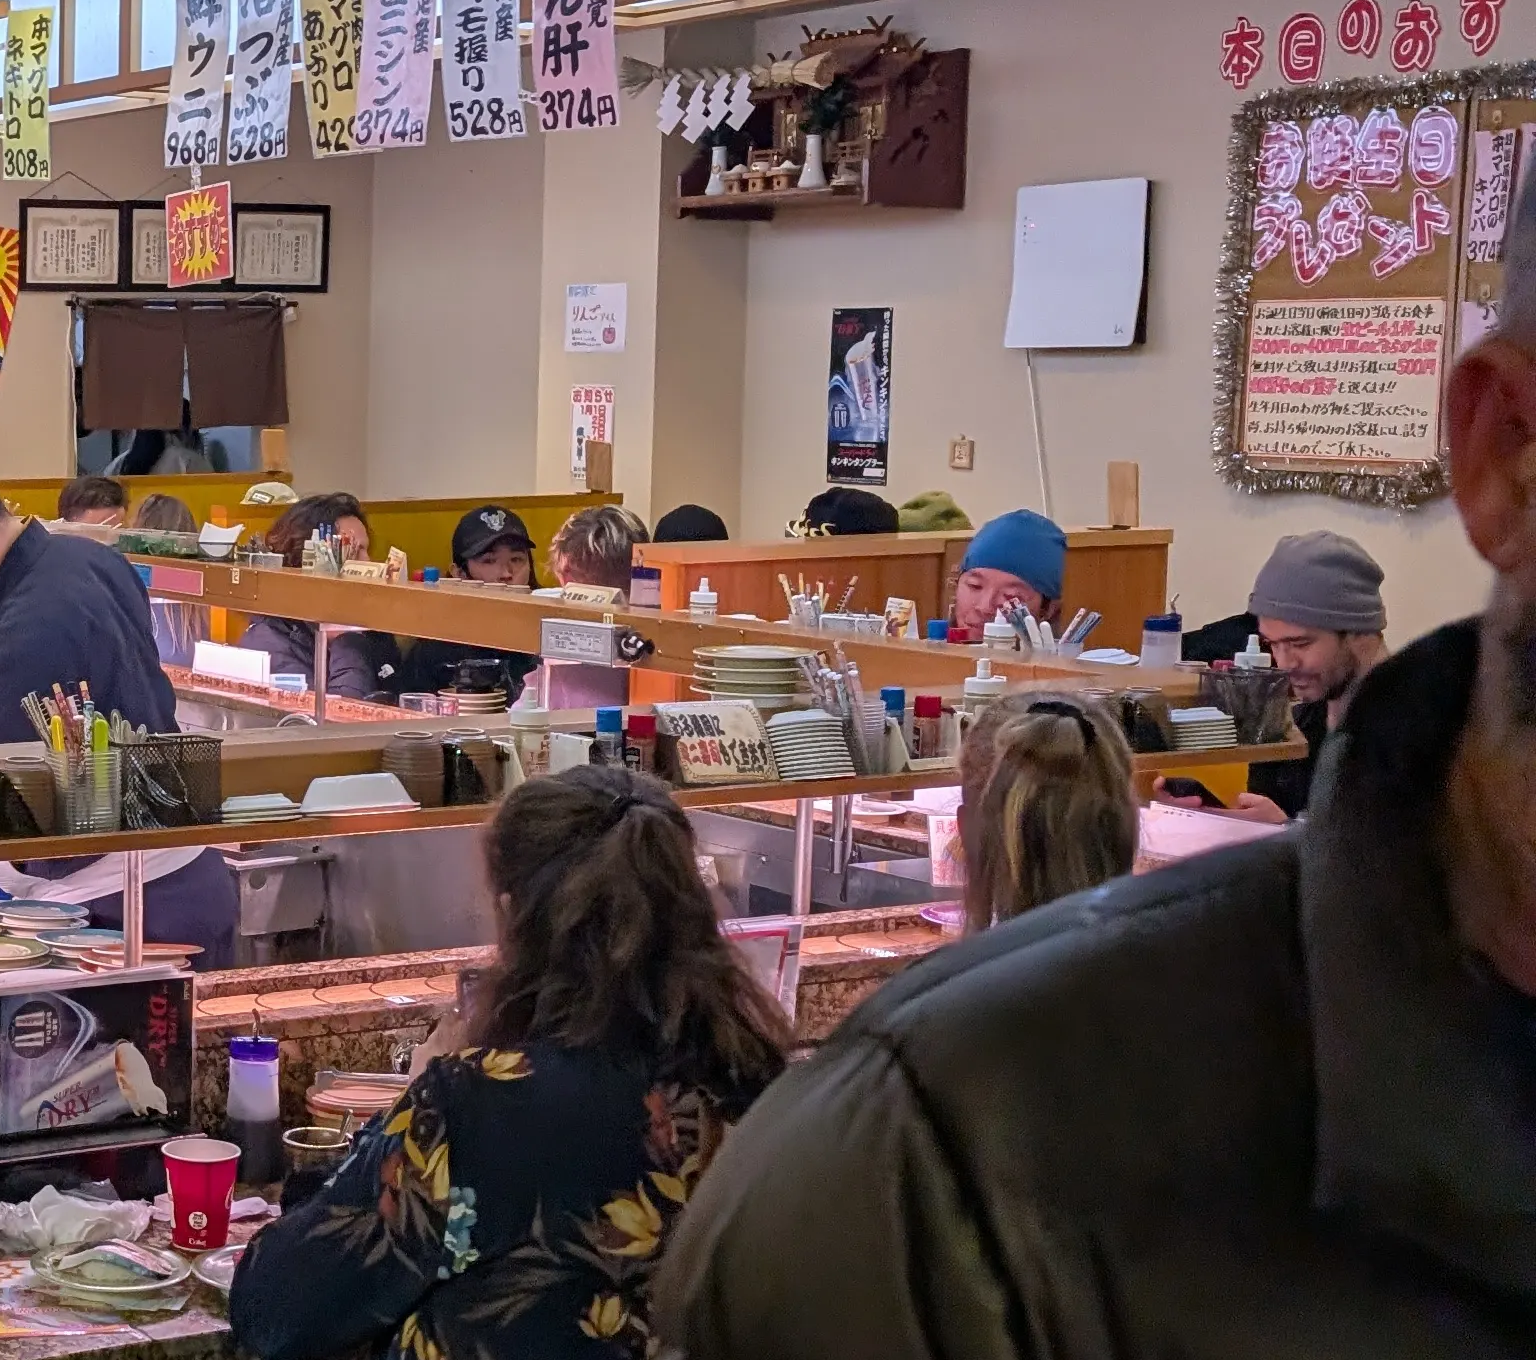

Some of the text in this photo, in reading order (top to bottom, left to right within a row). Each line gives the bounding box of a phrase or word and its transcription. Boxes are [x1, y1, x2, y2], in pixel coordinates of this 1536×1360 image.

[28, 14, 51, 118] 本マグロ
[302, 9, 328, 110] あぶり
[5, 35, 24, 139] ネギトロ
[356, 107, 423, 145] 374円
[450, 98, 524, 137] 528円
[540, 87, 616, 131] 374円
[167, 130, 217, 164] 968円
[229, 122, 285, 162] 528円
[316, 116, 355, 153] 42
[5, 149, 48, 177] 308円
[174, 207, 221, 263] おすすめ
[1253, 189, 1450, 282] プレゼント
[572, 390, 613, 403] お知らせ
